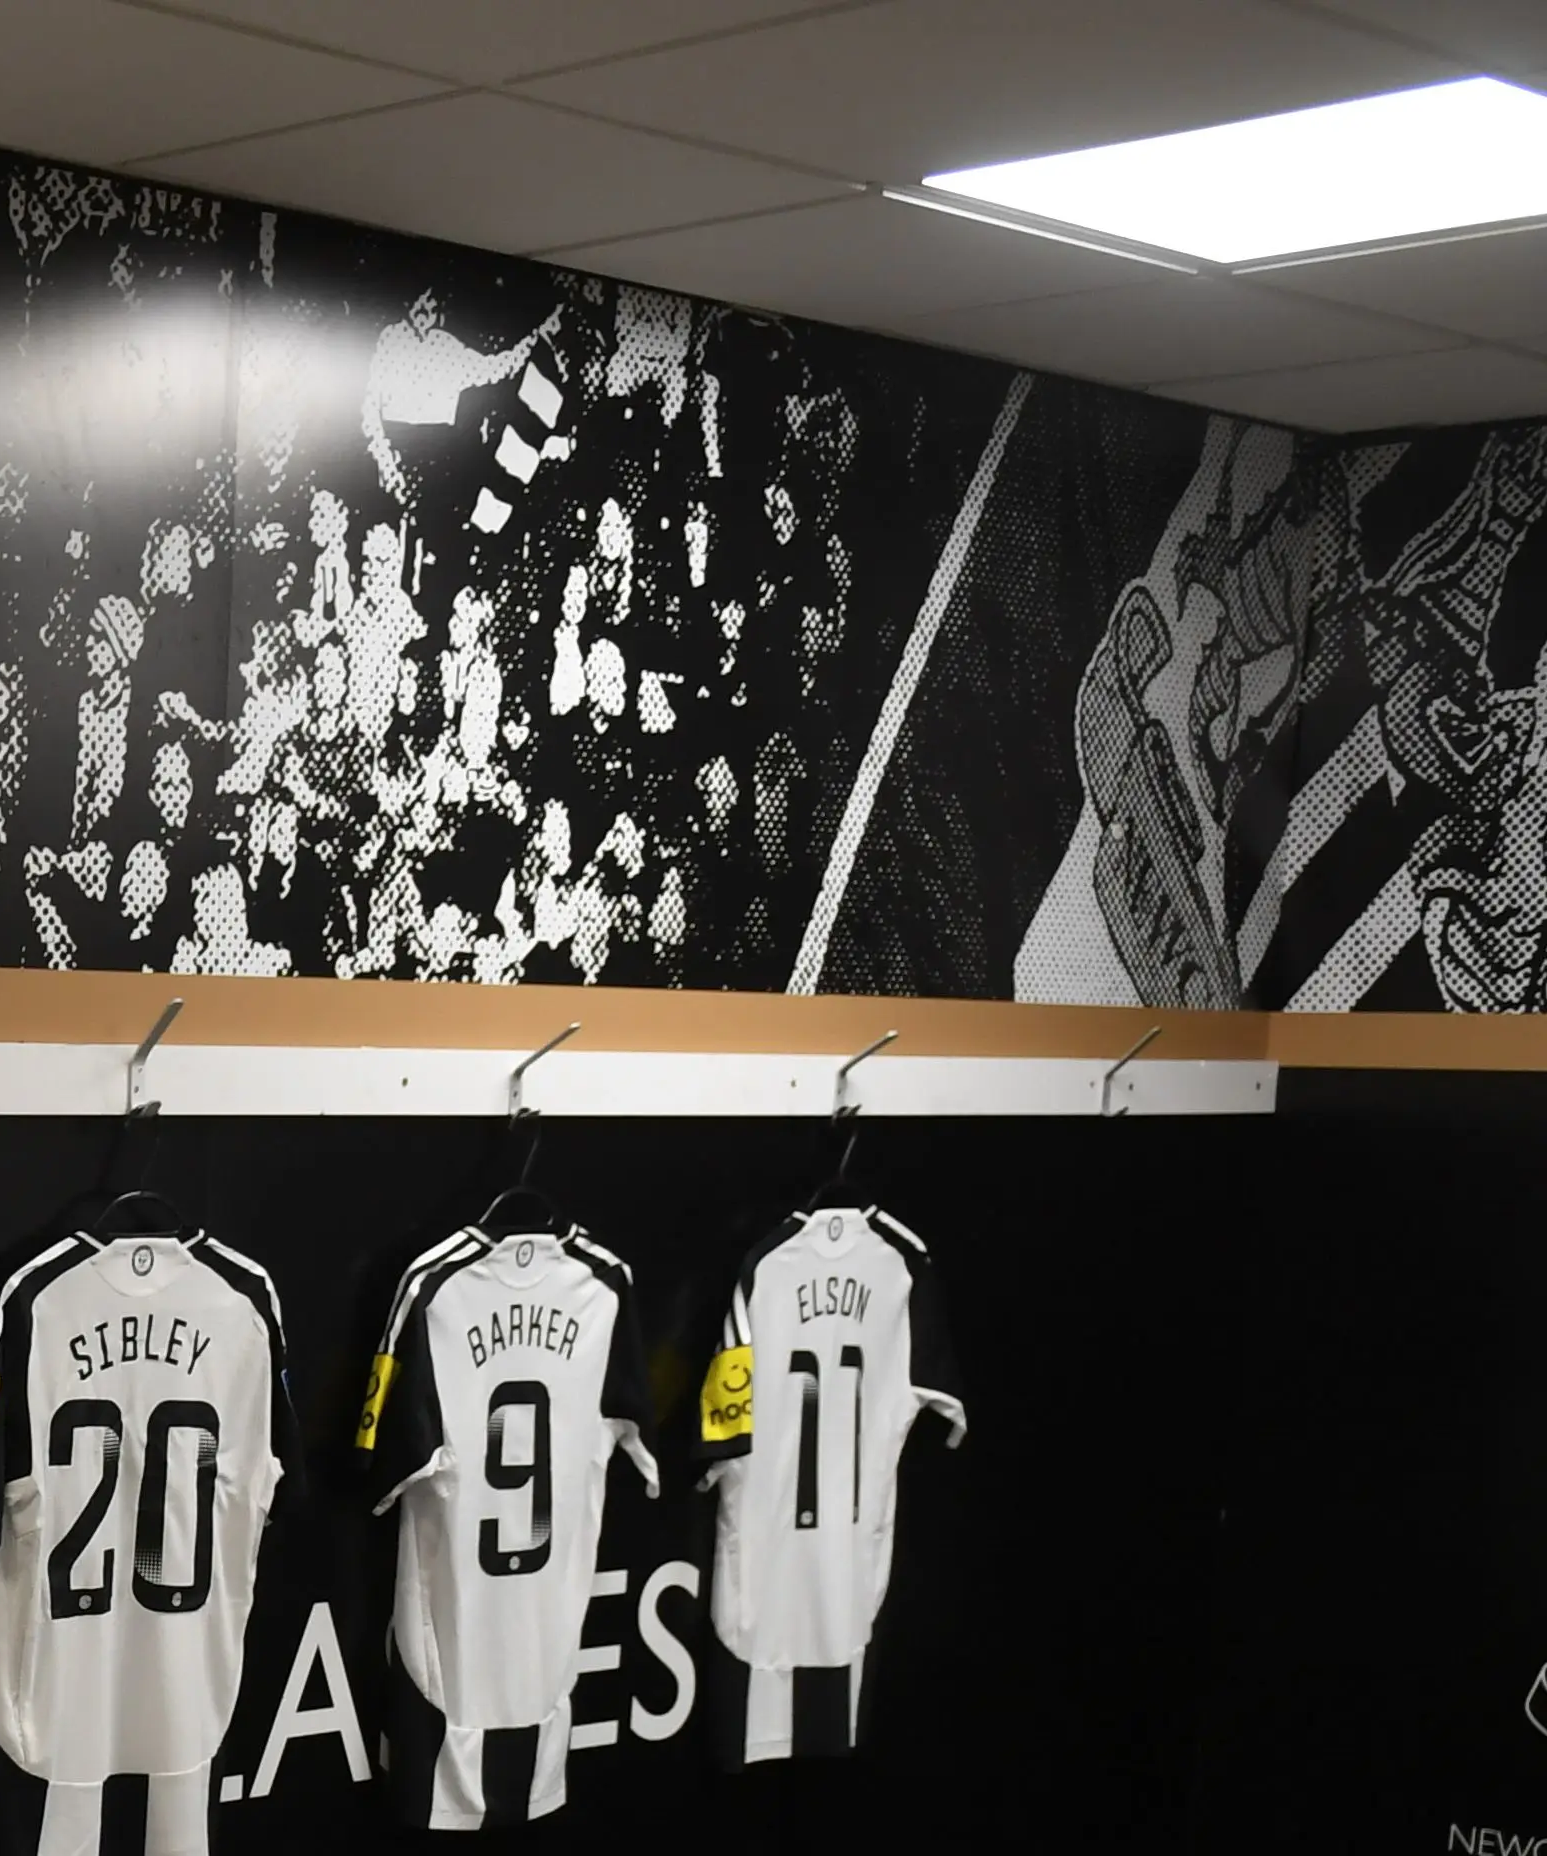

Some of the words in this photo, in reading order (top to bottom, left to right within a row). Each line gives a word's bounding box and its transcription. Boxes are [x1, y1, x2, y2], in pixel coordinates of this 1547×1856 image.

[798, 1277, 872, 1324] ELSON
[69, 1314, 211, 1381] SIBLEY
[467, 1303, 580, 1368] BARKER
[710, 1399, 751, 1425] noo
[789, 1345, 864, 1530] 11
[47, 1398, 220, 1620] 20
[477, 1380, 552, 1577] 9
